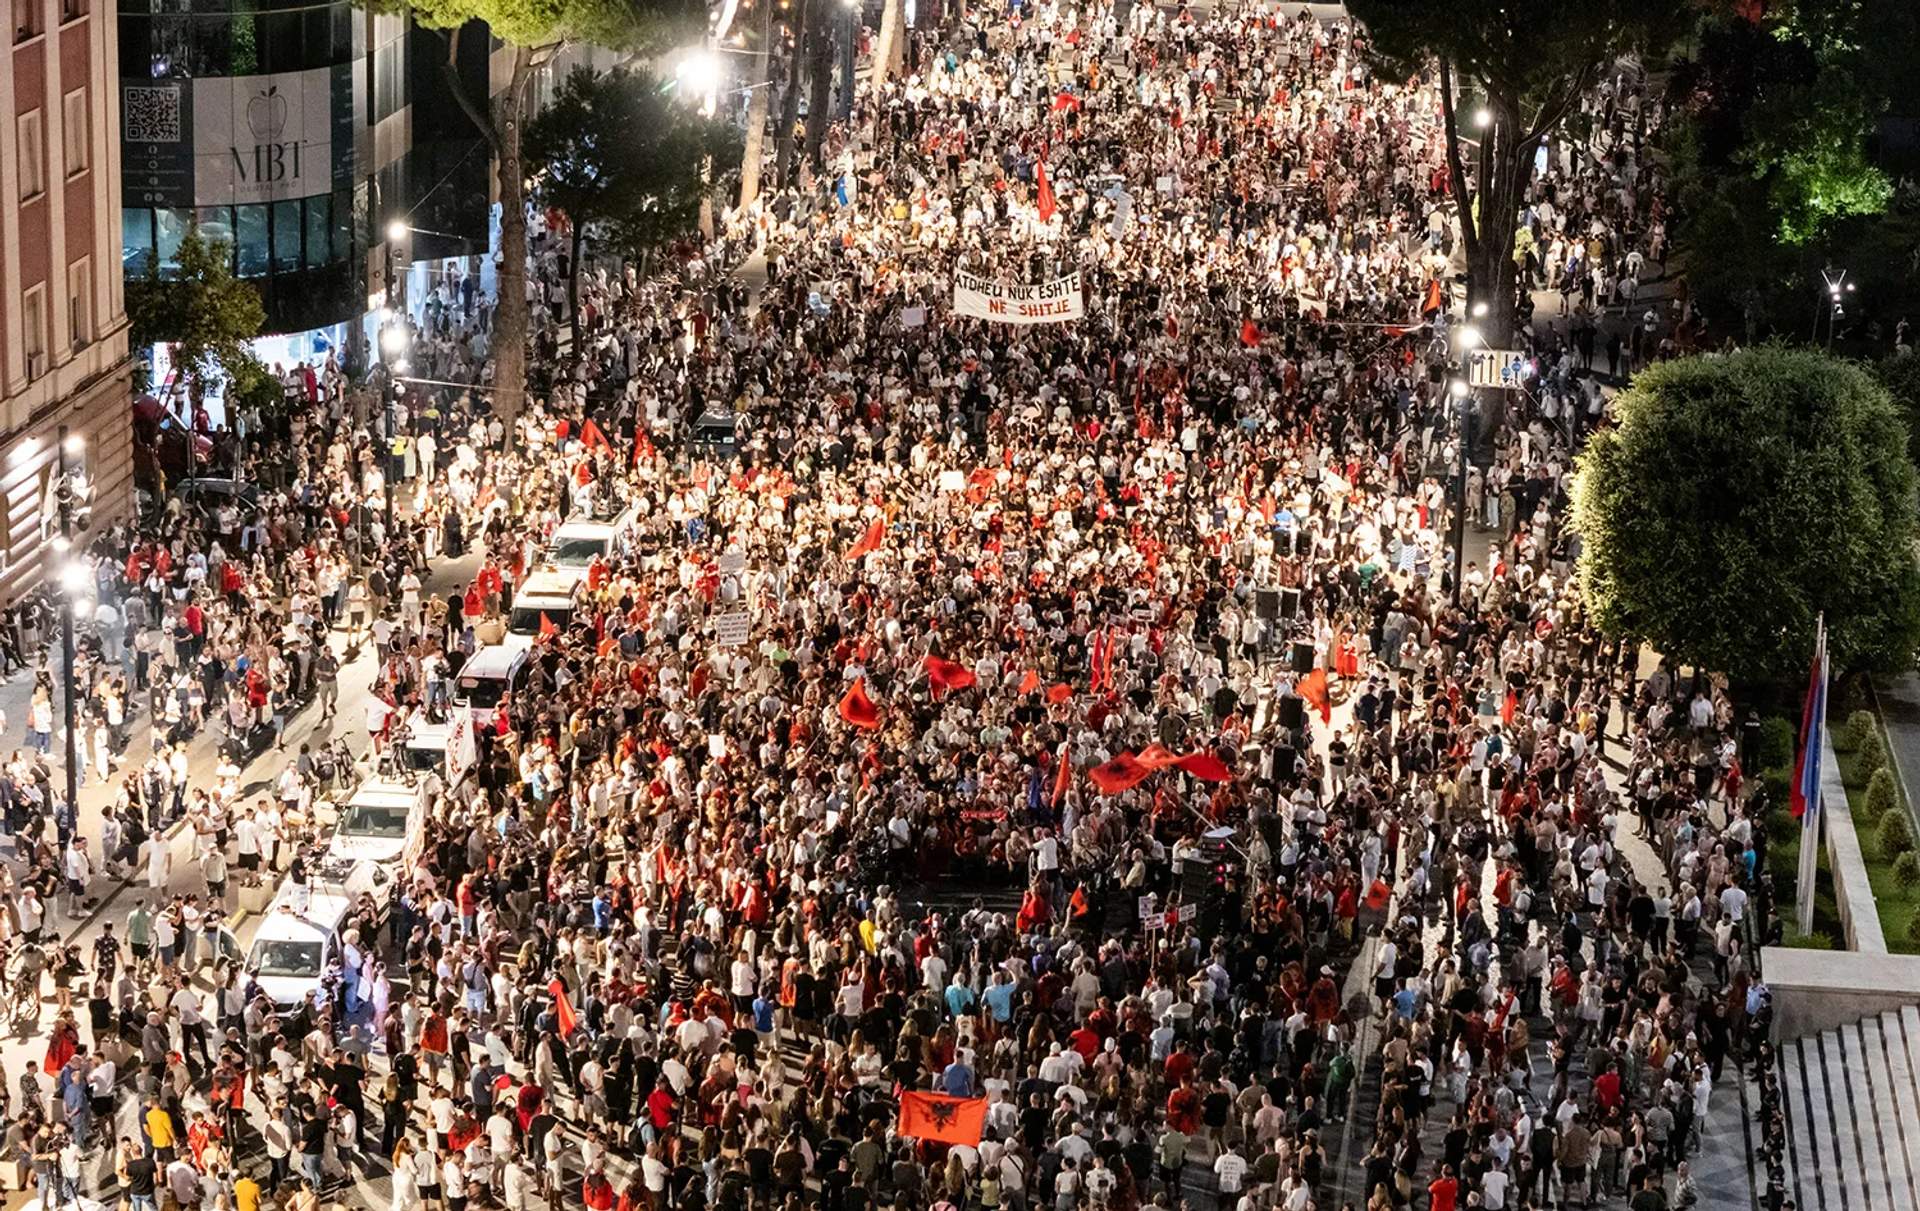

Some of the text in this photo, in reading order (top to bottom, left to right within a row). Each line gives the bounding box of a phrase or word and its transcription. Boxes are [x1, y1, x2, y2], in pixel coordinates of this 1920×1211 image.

[229, 140, 308, 183] MBT
[955, 274, 1080, 300] ATDHEU NUK ESHTE
[989, 300, 1071, 317] NE SHITJE
